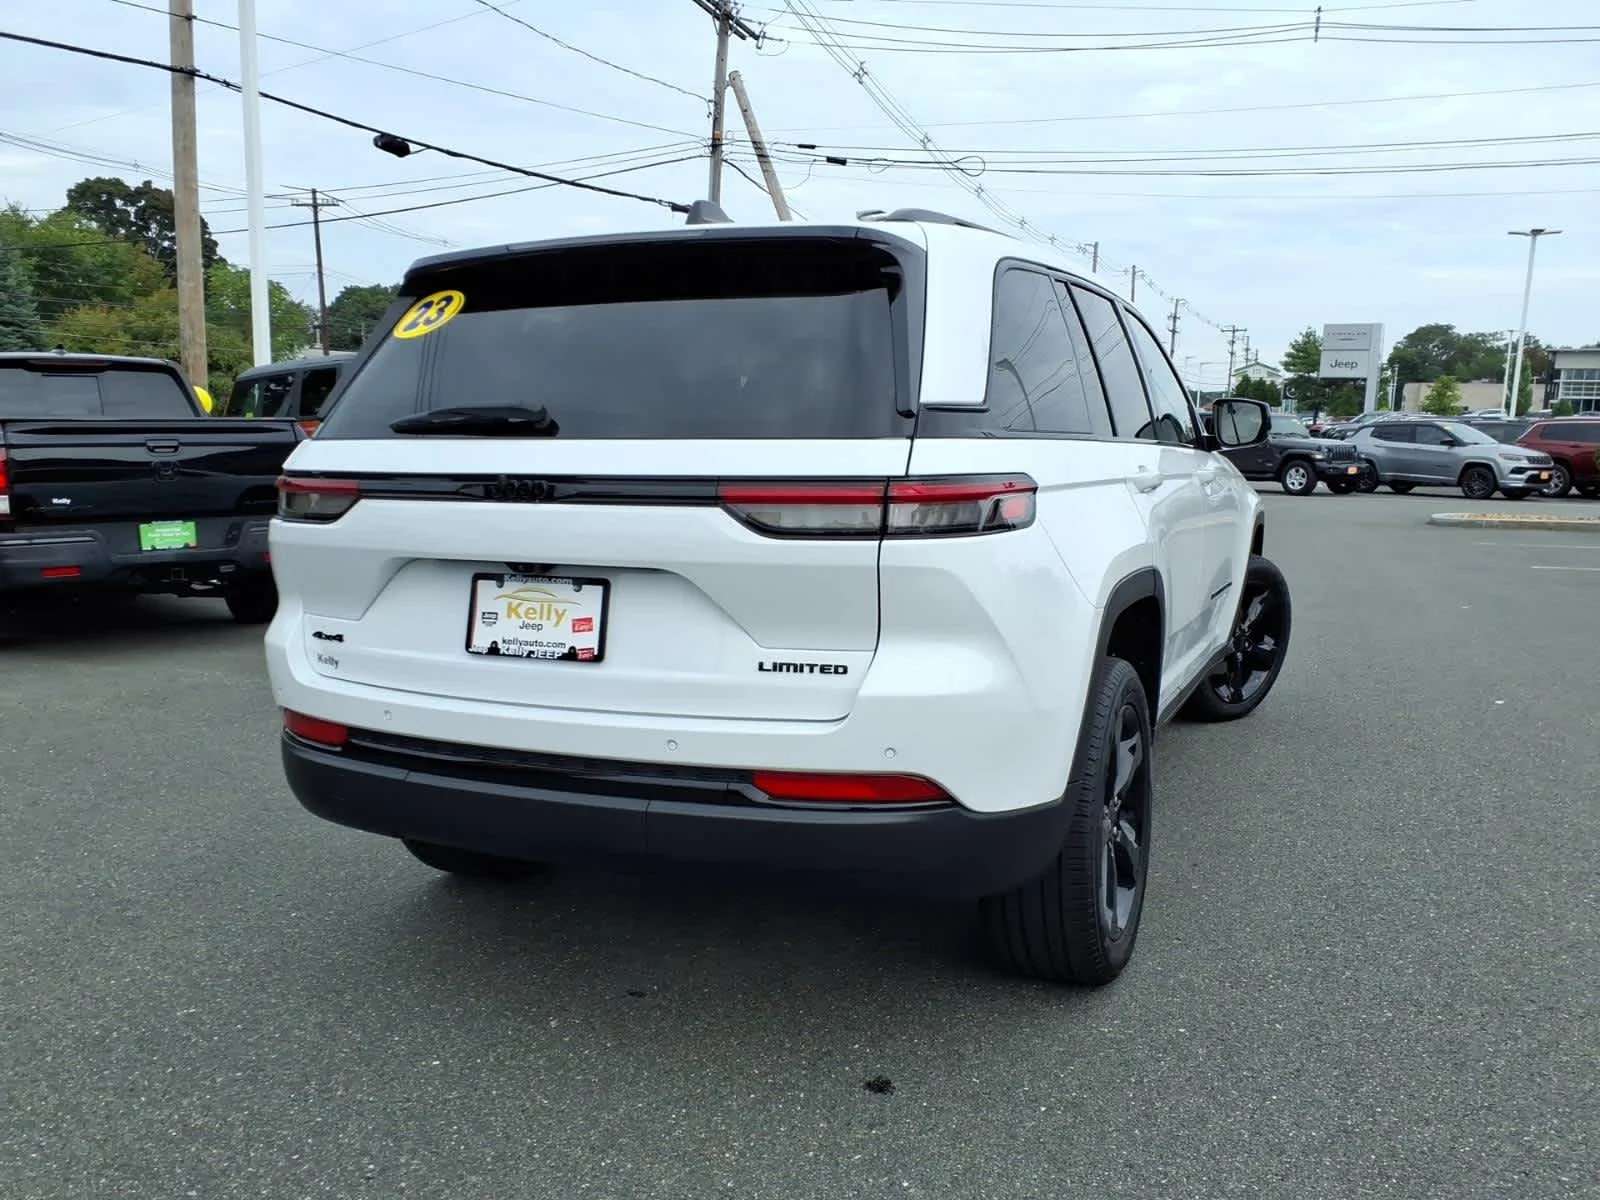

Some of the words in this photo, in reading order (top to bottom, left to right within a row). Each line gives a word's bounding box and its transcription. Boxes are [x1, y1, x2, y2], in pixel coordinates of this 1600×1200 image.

[402, 295, 454, 332] 23
[1330, 359, 1358, 370] Jeep
[503, 574, 573, 585] Kellyauto.com
[506, 601, 568, 627] Kelly
[519, 620, 543, 632] Jeep
[502, 637, 567, 650] kellyauto.com
[501, 646, 530, 657] Kelly
[530, 648, 563, 659] JEEP
[317, 652, 339, 669] Kelly
[758, 661, 848, 675] LIMITED
